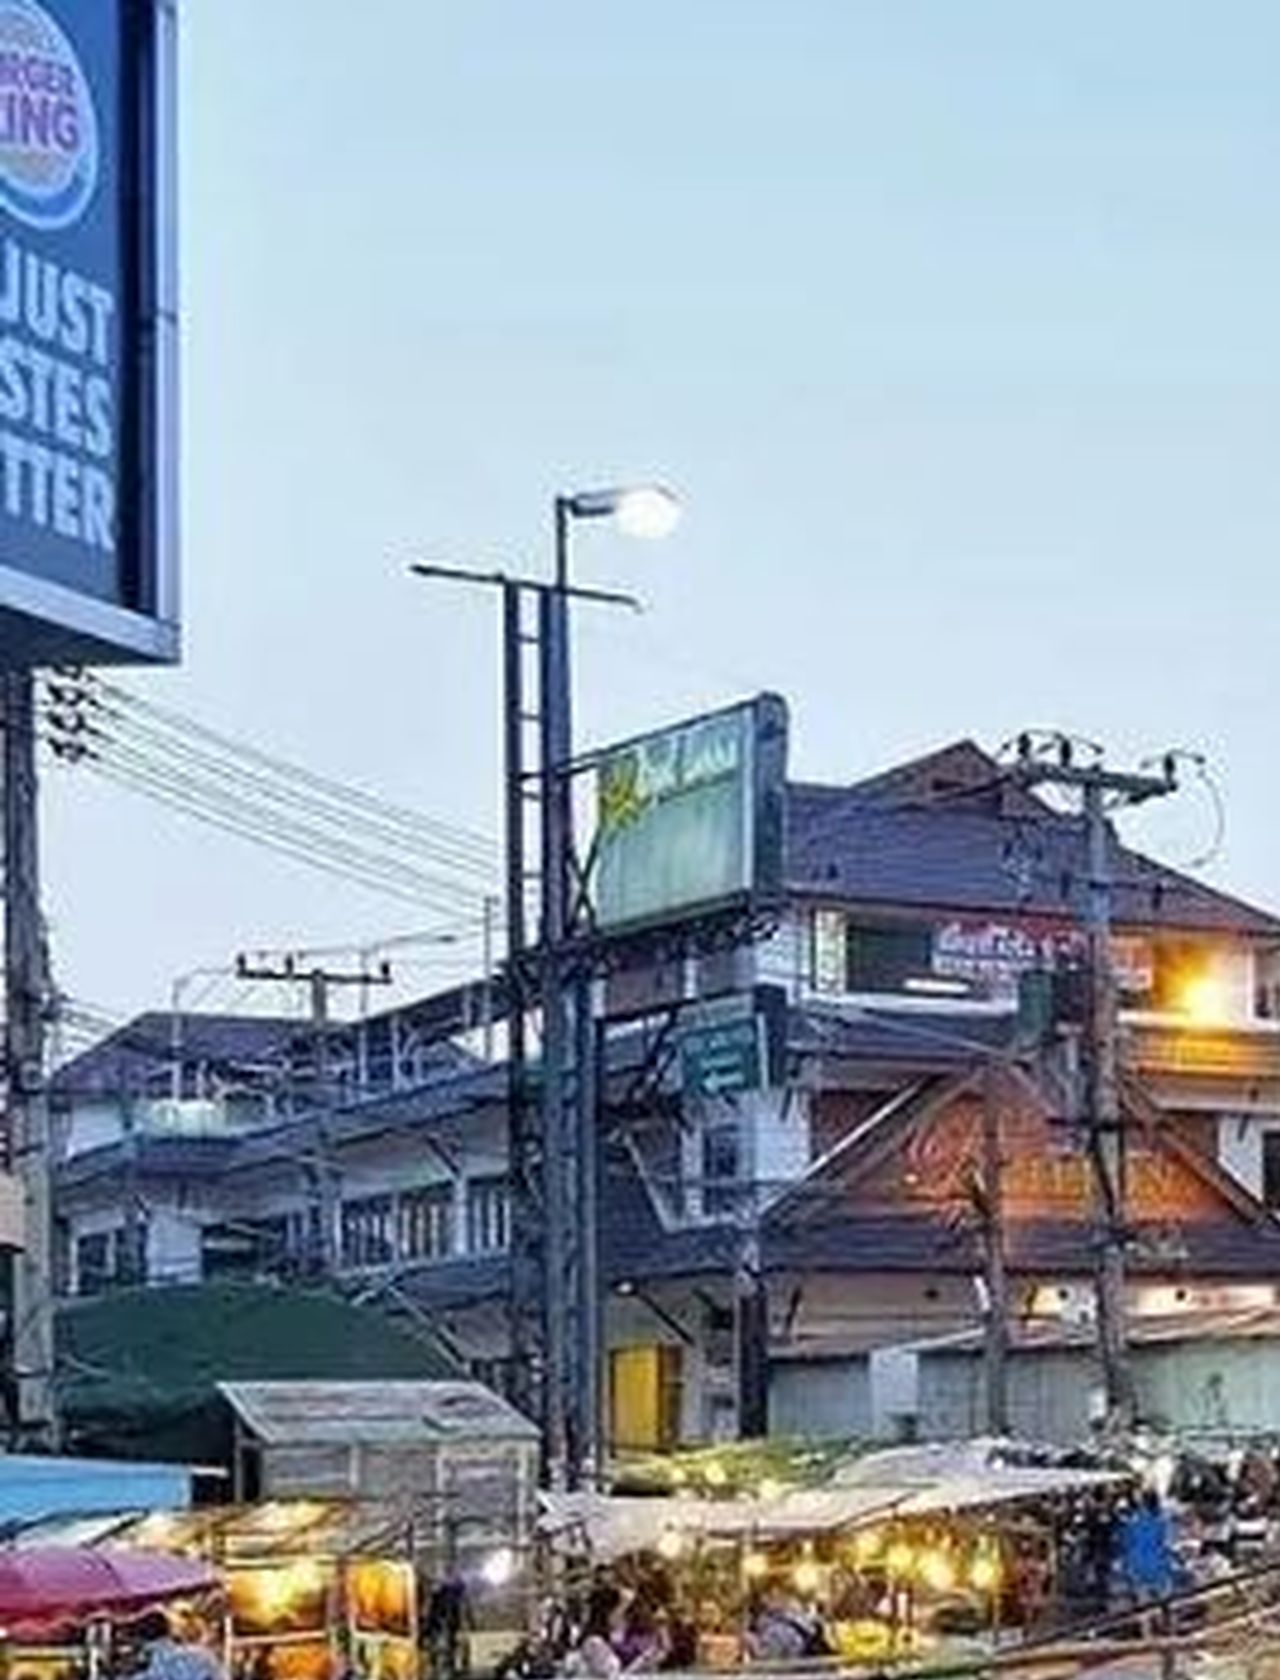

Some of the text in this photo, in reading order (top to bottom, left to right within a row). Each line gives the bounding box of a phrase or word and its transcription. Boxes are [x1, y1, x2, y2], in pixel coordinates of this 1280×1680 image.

[0, 92, 80, 150] ING
[0, 237, 114, 366] JUST
[0, 430, 115, 550] TTER
